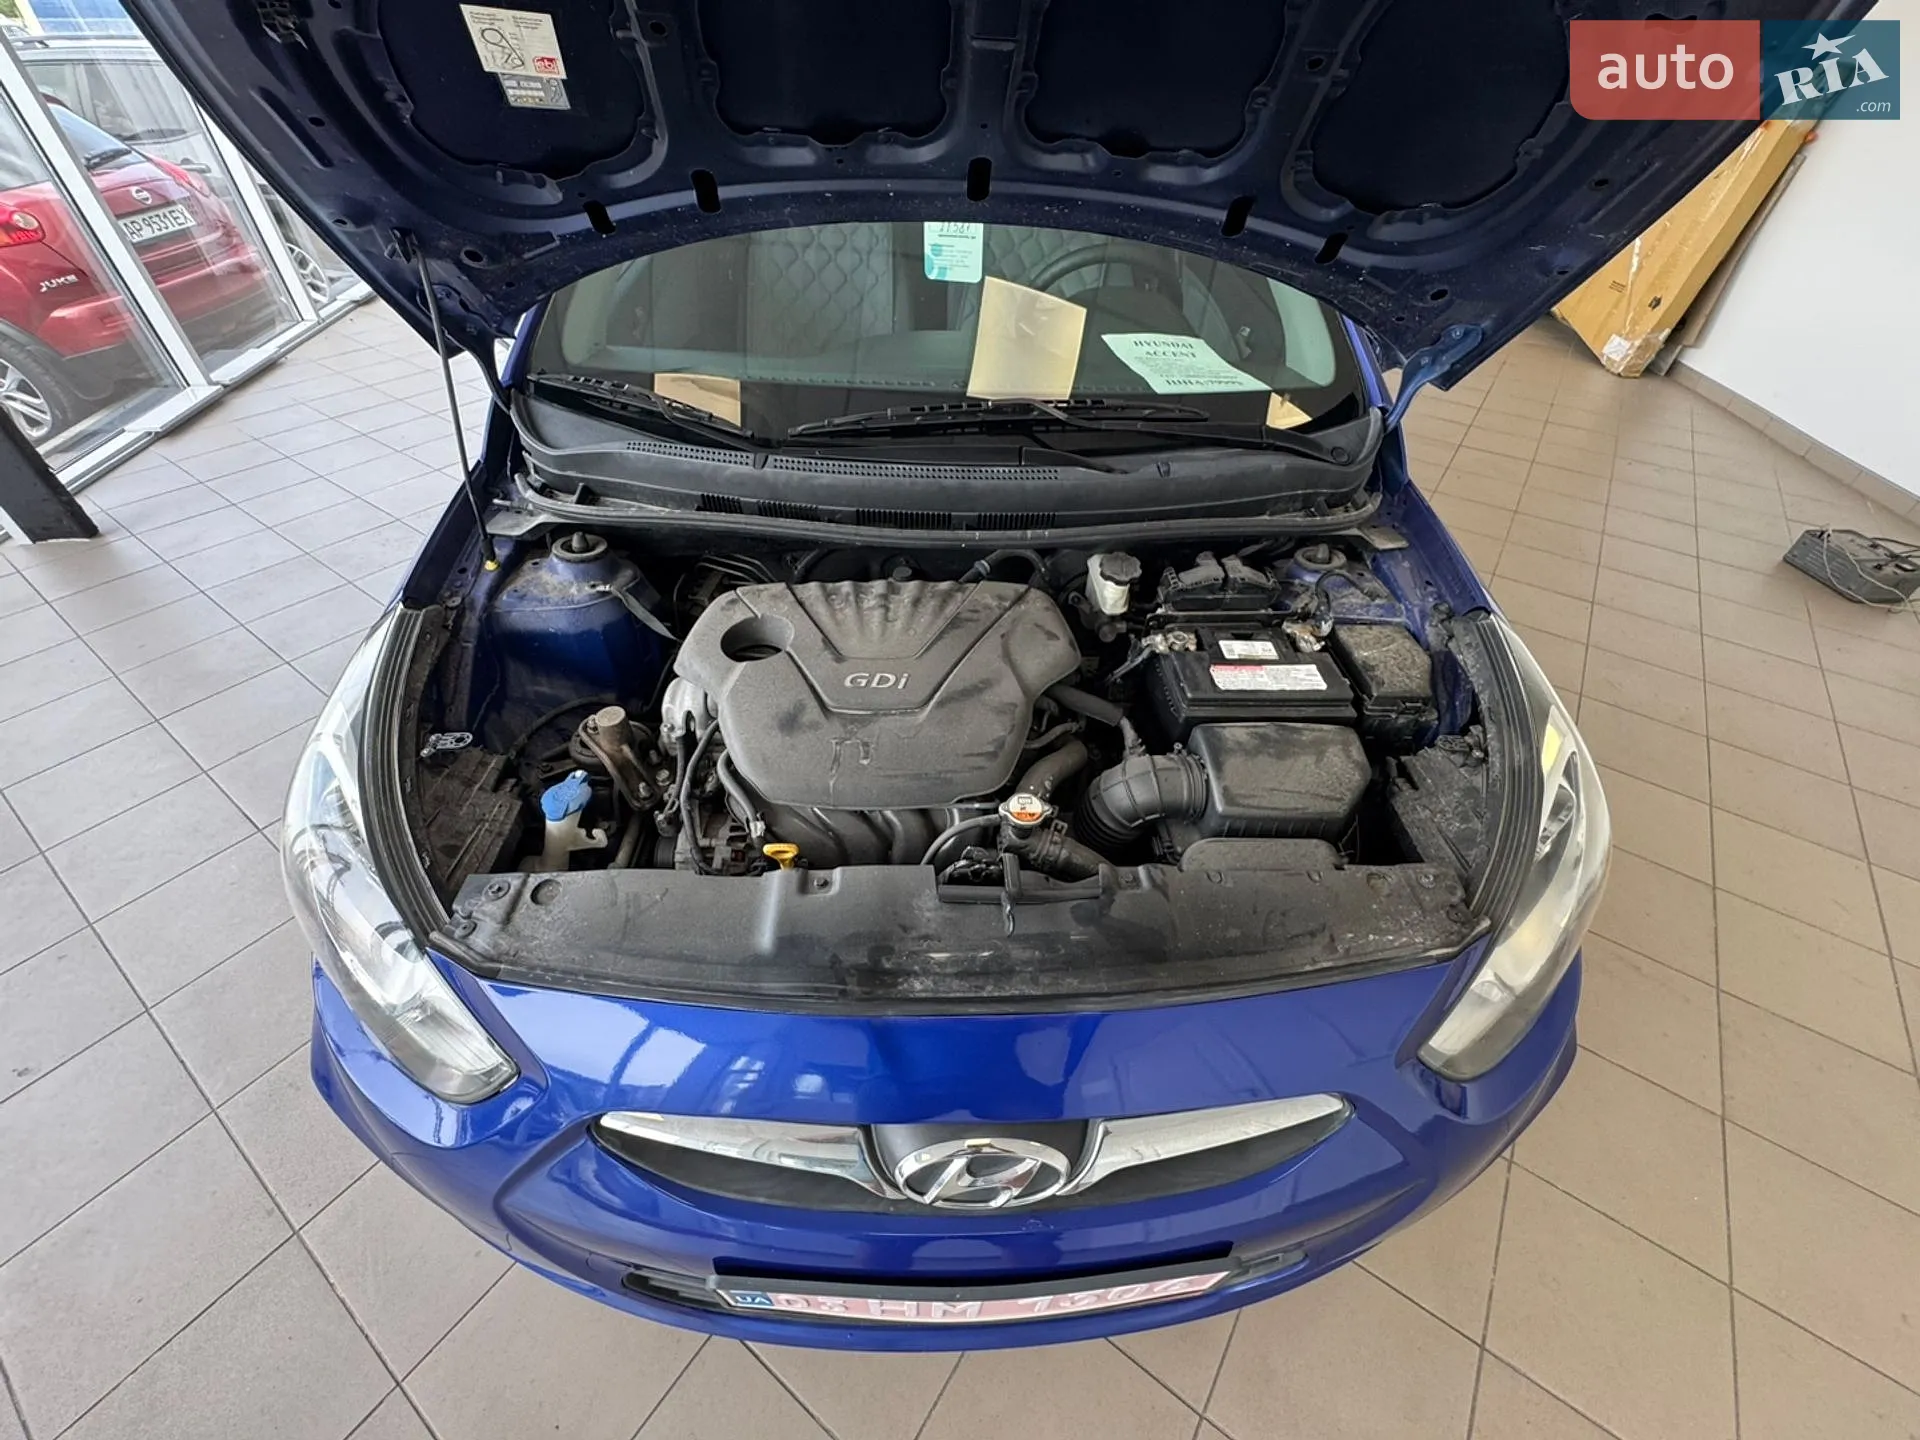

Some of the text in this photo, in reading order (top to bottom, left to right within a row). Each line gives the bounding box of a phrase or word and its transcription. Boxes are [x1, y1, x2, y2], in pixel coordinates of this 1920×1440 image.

[39, 274, 78, 292] JUKE
[1132, 340, 1196, 350] HYUNDAI
[1144, 351, 1197, 359] ACCENT
[843, 671, 909, 690] GDi
[735, 1294, 771, 1305] UA
